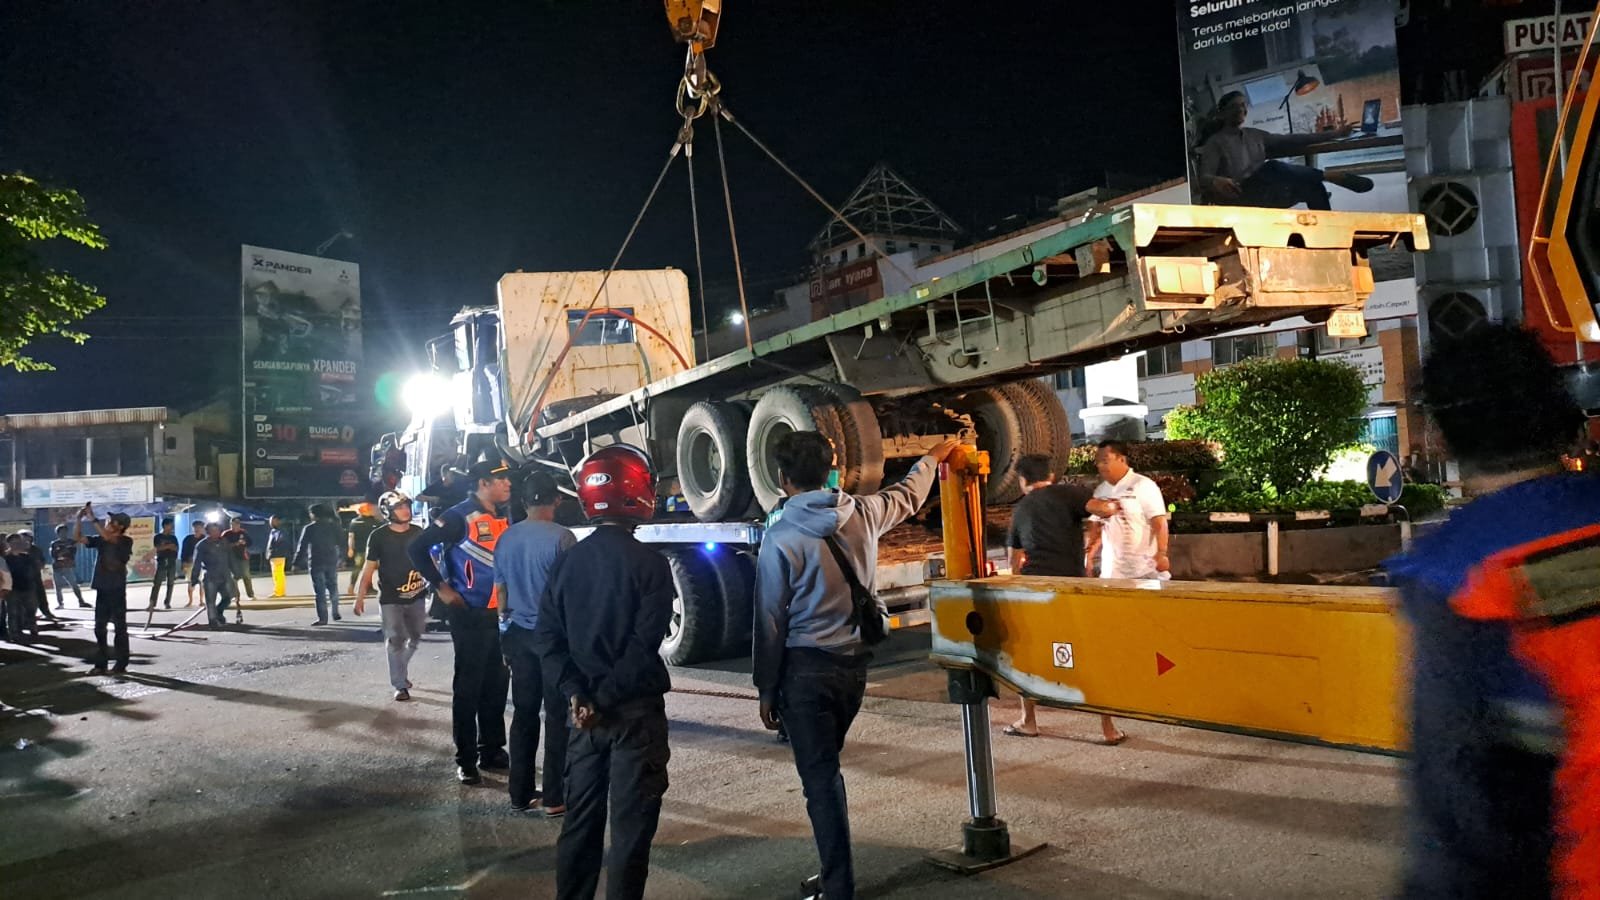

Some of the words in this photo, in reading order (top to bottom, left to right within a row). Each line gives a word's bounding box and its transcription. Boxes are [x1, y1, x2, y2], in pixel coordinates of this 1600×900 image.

[1192, 23, 1224, 37] Terus
[1225, 6, 1294, 29] melebarkan
[1216, 31, 1243, 44] kota
[1244, 27, 1259, 37] ke
[1261, 18, 1291, 33] kota!
[313, 359, 356, 374] XPANDER
[256, 423, 273, 433] DP
[309, 426, 339, 435] BUNGA
